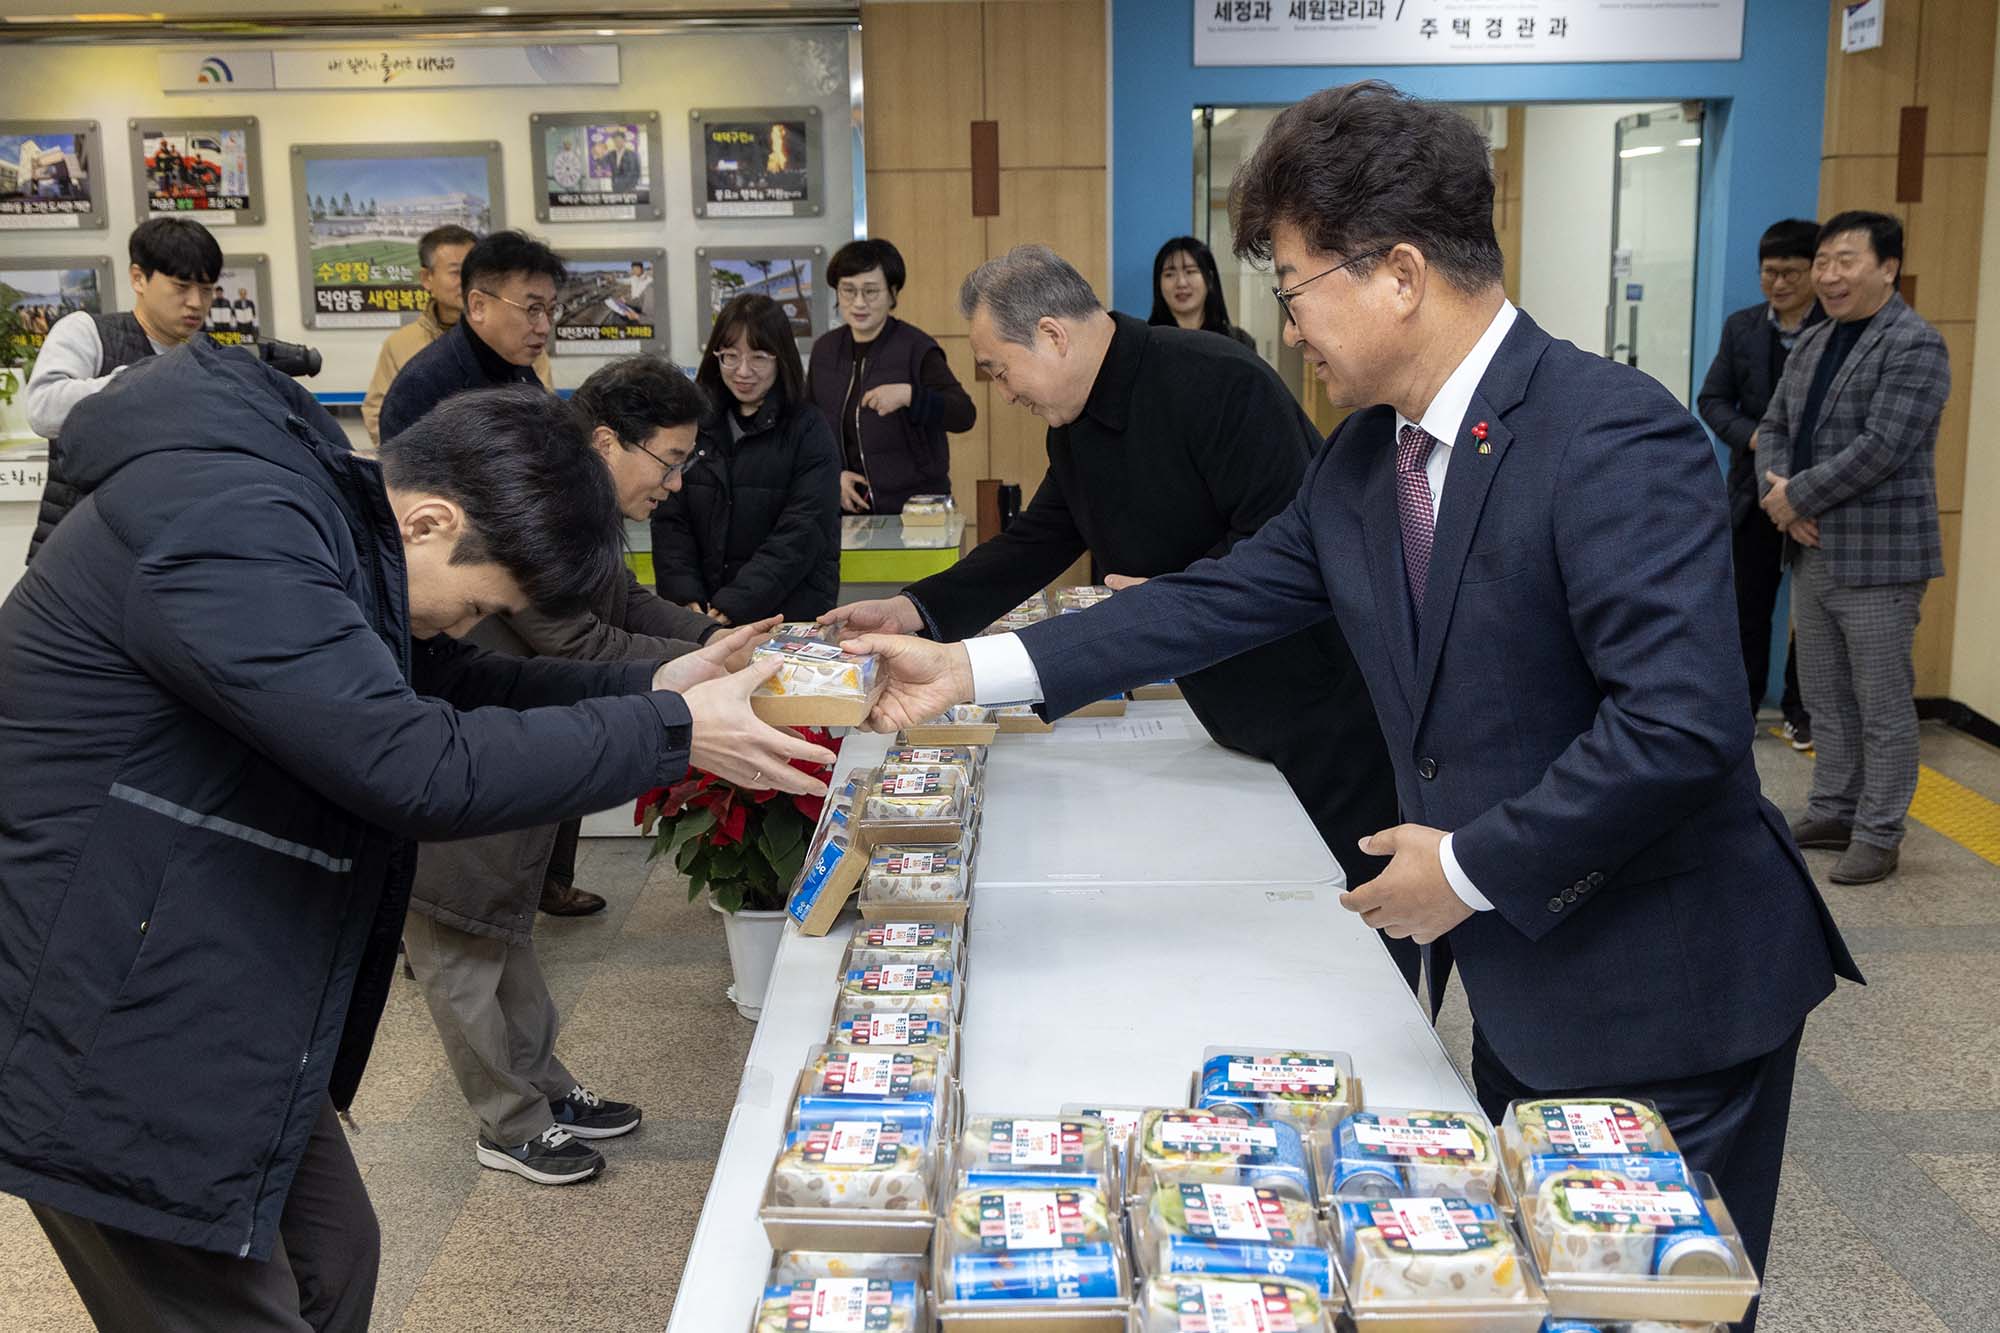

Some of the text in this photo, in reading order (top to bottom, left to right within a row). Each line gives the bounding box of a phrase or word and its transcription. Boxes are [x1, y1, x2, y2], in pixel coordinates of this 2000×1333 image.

[1214, 0, 1272, 22] 세정과
[1289, 0, 1385, 21] 세원관리과
[1419, 17, 1568, 40] 주택경관과
[318, 262, 414, 282] 수영장도 있는
[317, 289, 365, 312] 덕암동
[1267, 1247, 1296, 1274] Be
